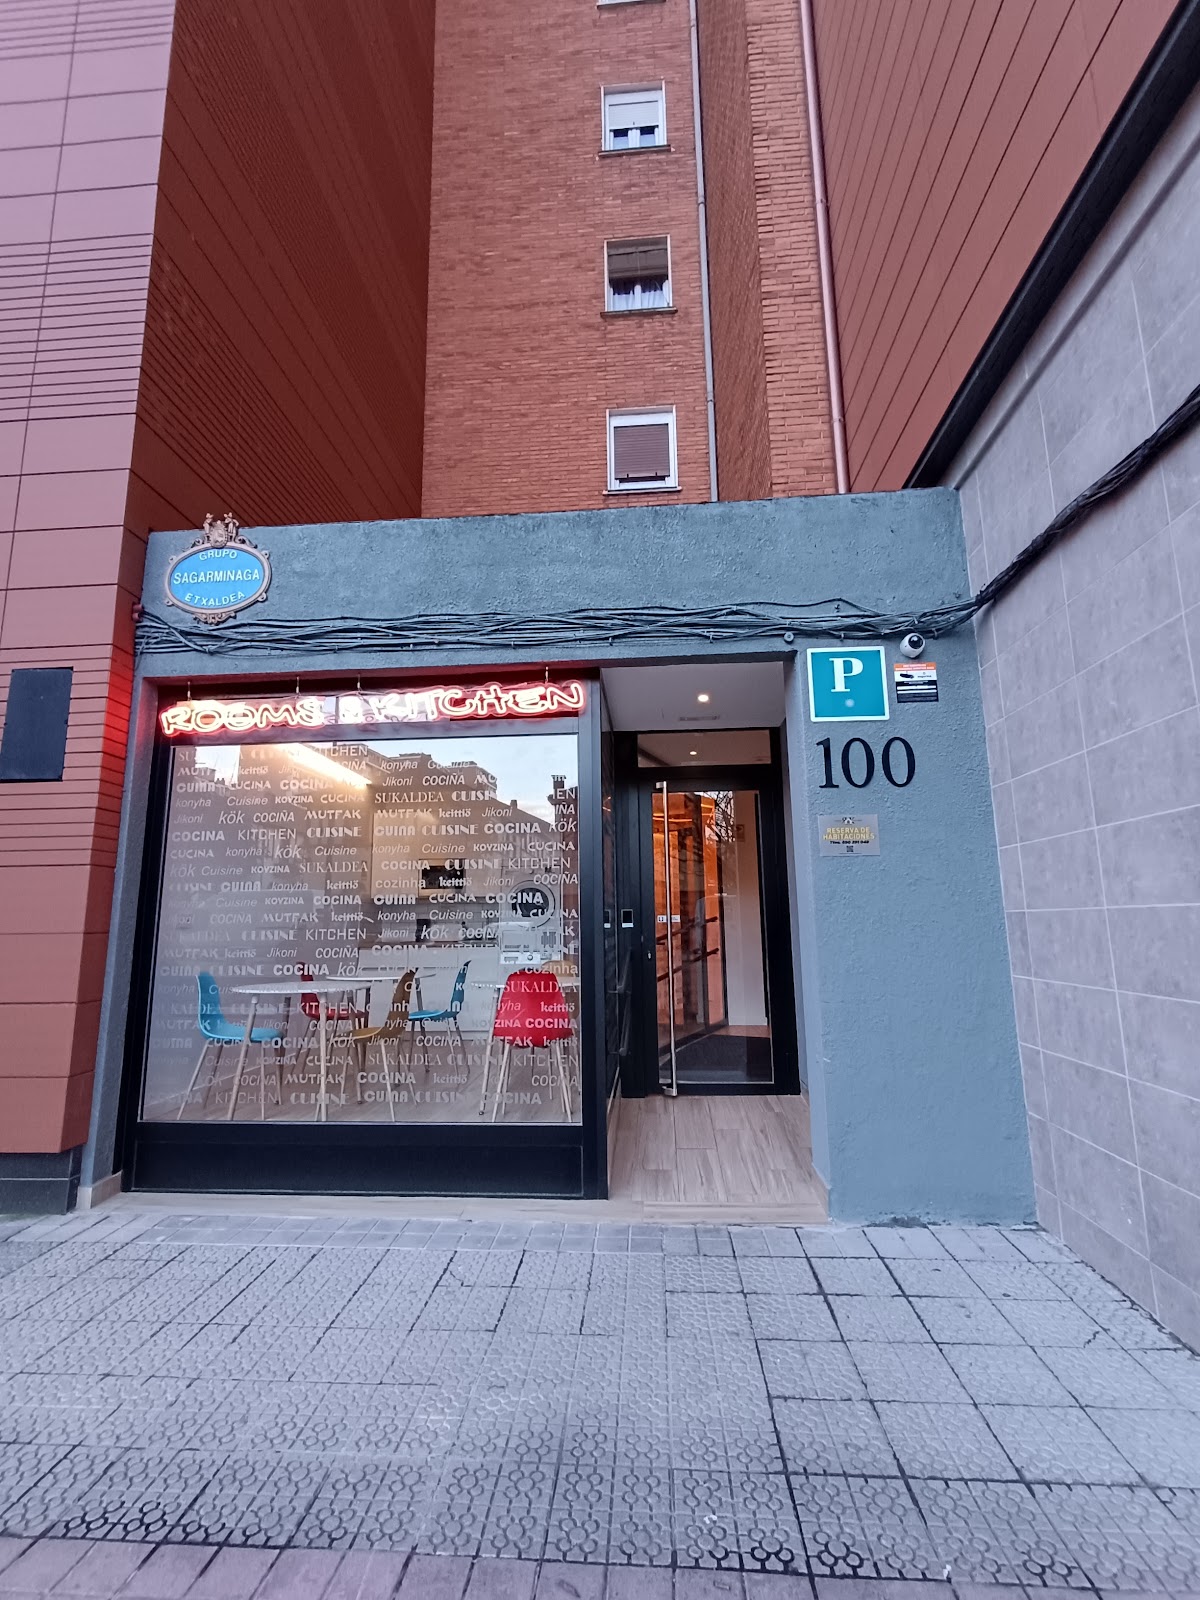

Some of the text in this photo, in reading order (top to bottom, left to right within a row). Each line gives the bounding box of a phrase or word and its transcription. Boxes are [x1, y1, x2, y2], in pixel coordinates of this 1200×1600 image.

[199, 548, 238, 561] GRUPO
[173, 568, 260, 585] SAGARMINAGA
[184, 590, 246, 606] ETXALDEA
[828, 657, 864, 692] P
[161, 698, 325, 735] ROOMS
[381, 760, 418, 771] konyha
[816, 736, 916, 788] 100
[280, 778, 333, 790] COCINA
[383, 775, 413, 786] Jikoni
[422, 773, 465, 786] COCIÑA
[175, 797, 211, 810] konyha
[227, 795, 269, 806] Cuisine
[320, 793, 365, 803] CUCINA
[374, 791, 444, 803] SUKALDEA
[174, 813, 204, 824] Jikoni
[218, 810, 245, 824] kök
[253, 810, 295, 823] COCIÑA
[304, 809, 361, 820] MUTFAK
[375, 808, 434, 820] MUTFAK
[438, 808, 471, 818] keittiö
[481, 806, 513, 818] Jikoni
[171, 830, 225, 842] COCINA
[237, 828, 297, 841] KITCHEN
[306, 826, 362, 838] CUISINE
[421, 824, 479, 836] CUISINE
[483, 822, 541, 834] COCINA
[822, 832, 875, 840] HABITACIONES
[169, 848, 215, 860] CUCINA
[225, 846, 262, 858] konyha
[273, 843, 302, 859] kök
[314, 845, 358, 856] Cuisine
[371, 843, 410, 855] konyha
[421, 843, 466, 854] Cuisine
[527, 841, 575, 852] CUCINA
[169, 863, 196, 877] kök
[201, 865, 243, 876] Cuisine
[299, 861, 368, 873] SUKALDEA
[380, 860, 430, 870] COCINA
[444, 858, 502, 870] CUISINE
[508, 857, 571, 869] KITCHEN
[271, 881, 308, 893] konyha
[326, 880, 359, 890] keittiö
[375, 877, 426, 889] cozinha
[439, 876, 472, 887] keittiö
[483, 875, 514, 887] Jikoni
[533, 871, 578, 885] COCIÑA
[215, 897, 257, 908] Cuisine
[313, 895, 362, 905] COCINA
[429, 892, 476, 903] CUCINA
[485, 892, 543, 904] COCINA
[261, 912, 319, 923] MUTFAK
[377, 910, 416, 923] konyha
[429, 909, 474, 920] Cuisine
[241, 929, 298, 941] CUISINE
[305, 928, 367, 941] KITCHEN
[378, 927, 409, 938] Jikoni
[420, 924, 449, 940] kök
[161, 948, 218, 959] MUTFAK
[267, 946, 298, 958] Jikoni
[315, 944, 359, 958] COCIÑA
[371, 944, 428, 956] COCINA
[273, 963, 330, 976] COCINA
[539, 1001, 575, 1013] keittiö
[525, 1018, 578, 1029] COCINA
[261, 1037, 319, 1049] COCINA
[368, 1053, 441, 1065] SUKALDEA
[357, 1071, 416, 1084] COCINA
